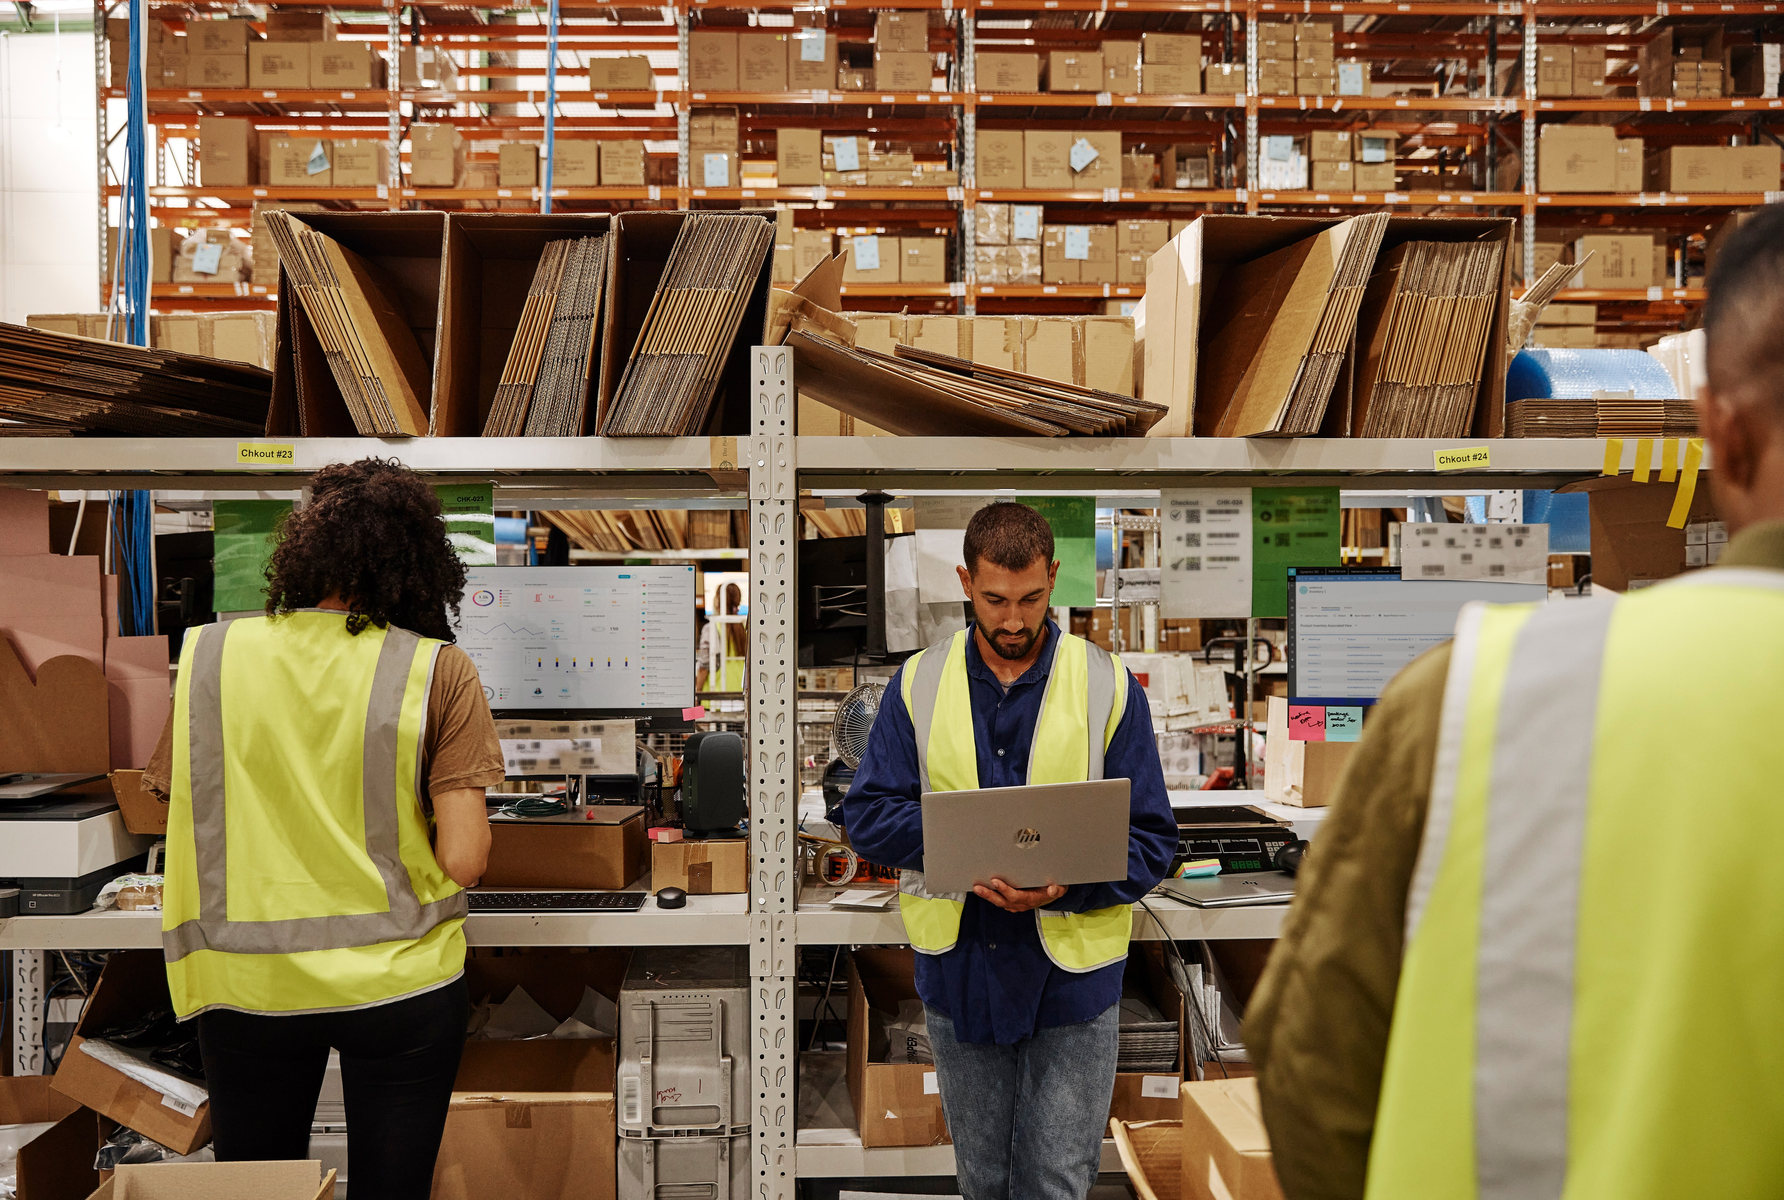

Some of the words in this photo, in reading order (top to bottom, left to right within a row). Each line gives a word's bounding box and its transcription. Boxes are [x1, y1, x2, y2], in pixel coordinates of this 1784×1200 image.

[241, 448, 274, 458] Chkout
[276, 450, 293, 459] #23
[1438, 455, 1470, 464] Chkout
[1472, 452, 1488, 461] #24
[1279, 499, 1294, 507] Stop
